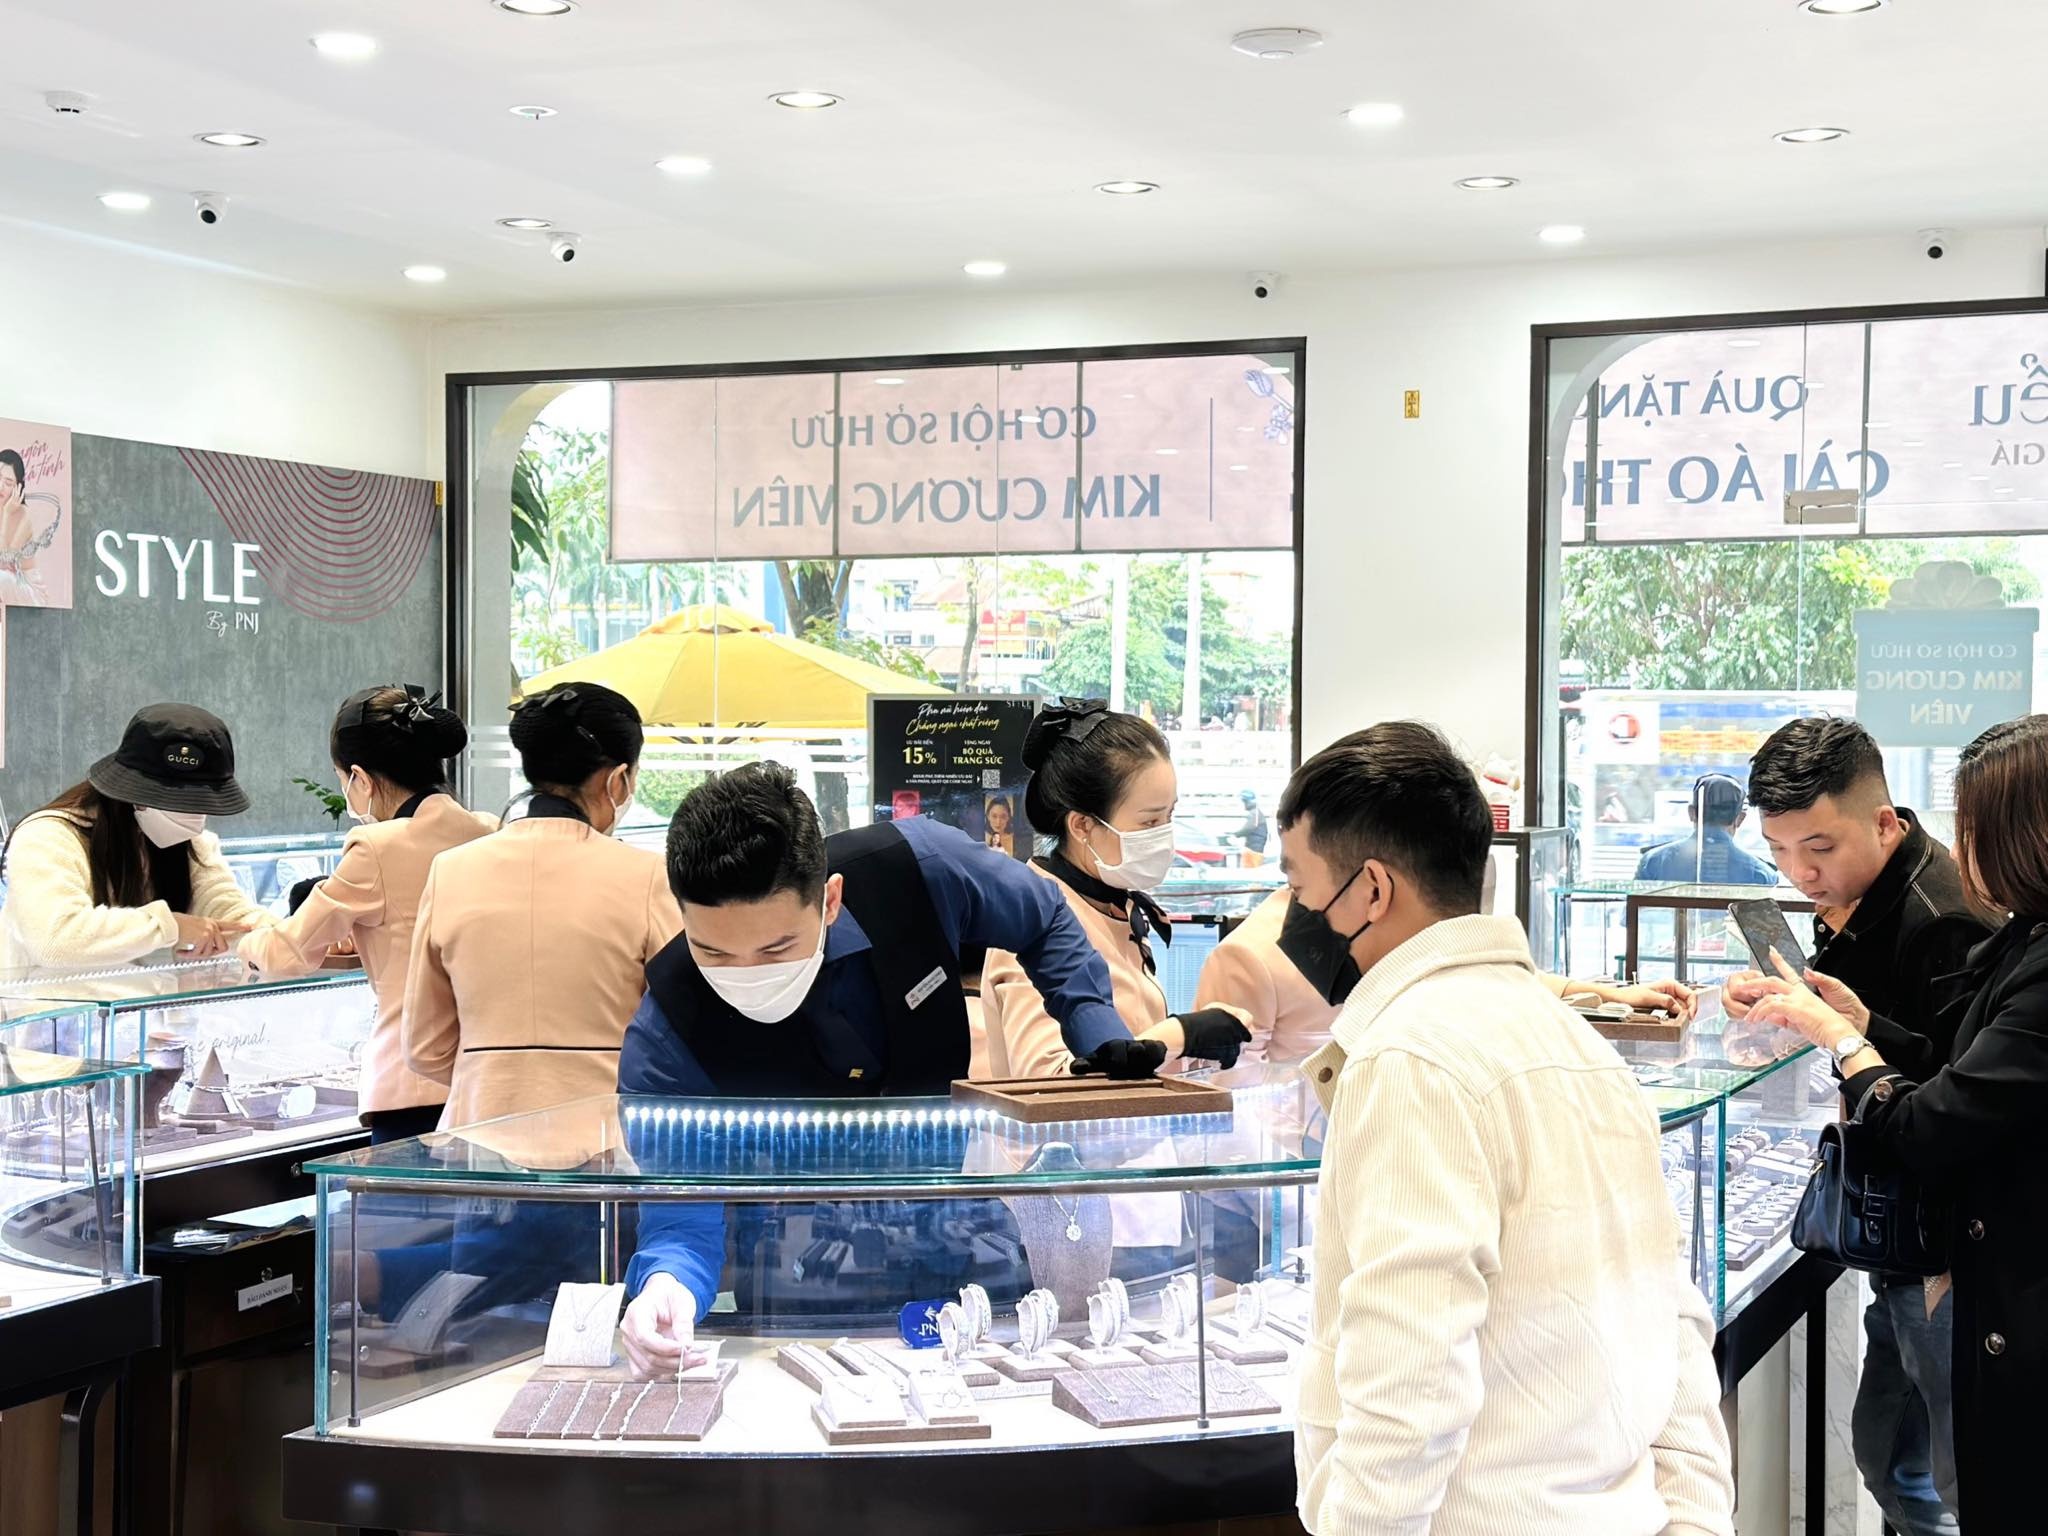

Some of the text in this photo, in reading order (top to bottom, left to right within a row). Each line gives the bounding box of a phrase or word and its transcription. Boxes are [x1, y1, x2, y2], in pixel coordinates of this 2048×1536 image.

[94, 529, 261, 605] STYLE
[206, 610, 260, 637] By PNJ
[167, 754, 200, 766] GUCCI
[902, 747, 937, 765] 15%
[952, 755, 1004, 765] TRANG SỨC
